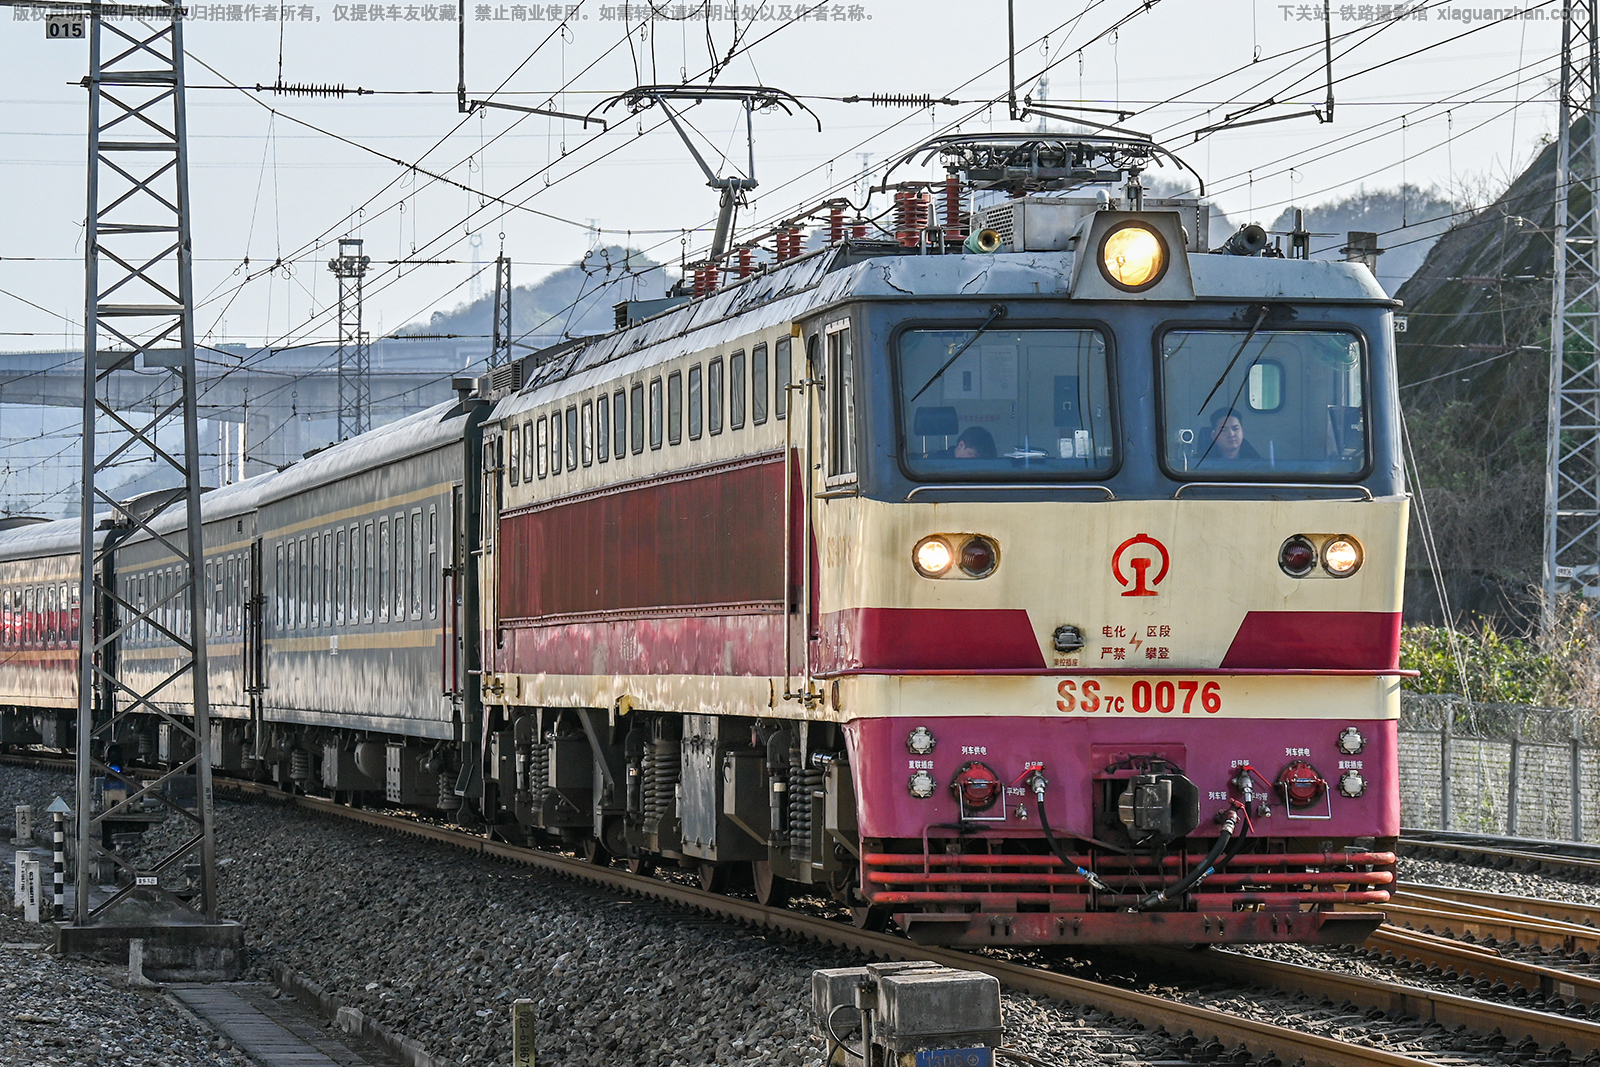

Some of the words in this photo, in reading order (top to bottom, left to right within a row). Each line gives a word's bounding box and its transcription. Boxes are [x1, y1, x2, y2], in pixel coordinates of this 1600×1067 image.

[50, 23, 82, 37] 015
[1102, 625, 1126, 637] 电化
[1147, 625, 1171, 637] 区段
[1100, 647, 1126, 660] 严禁
[1145, 647, 1170, 660] 攀登
[1132, 681, 1221, 713] 0076
[961, 746, 987, 755] 列车供电
[1286, 748, 1310, 757] 列车供电
[1338, 761, 1363, 770] 重联插座
